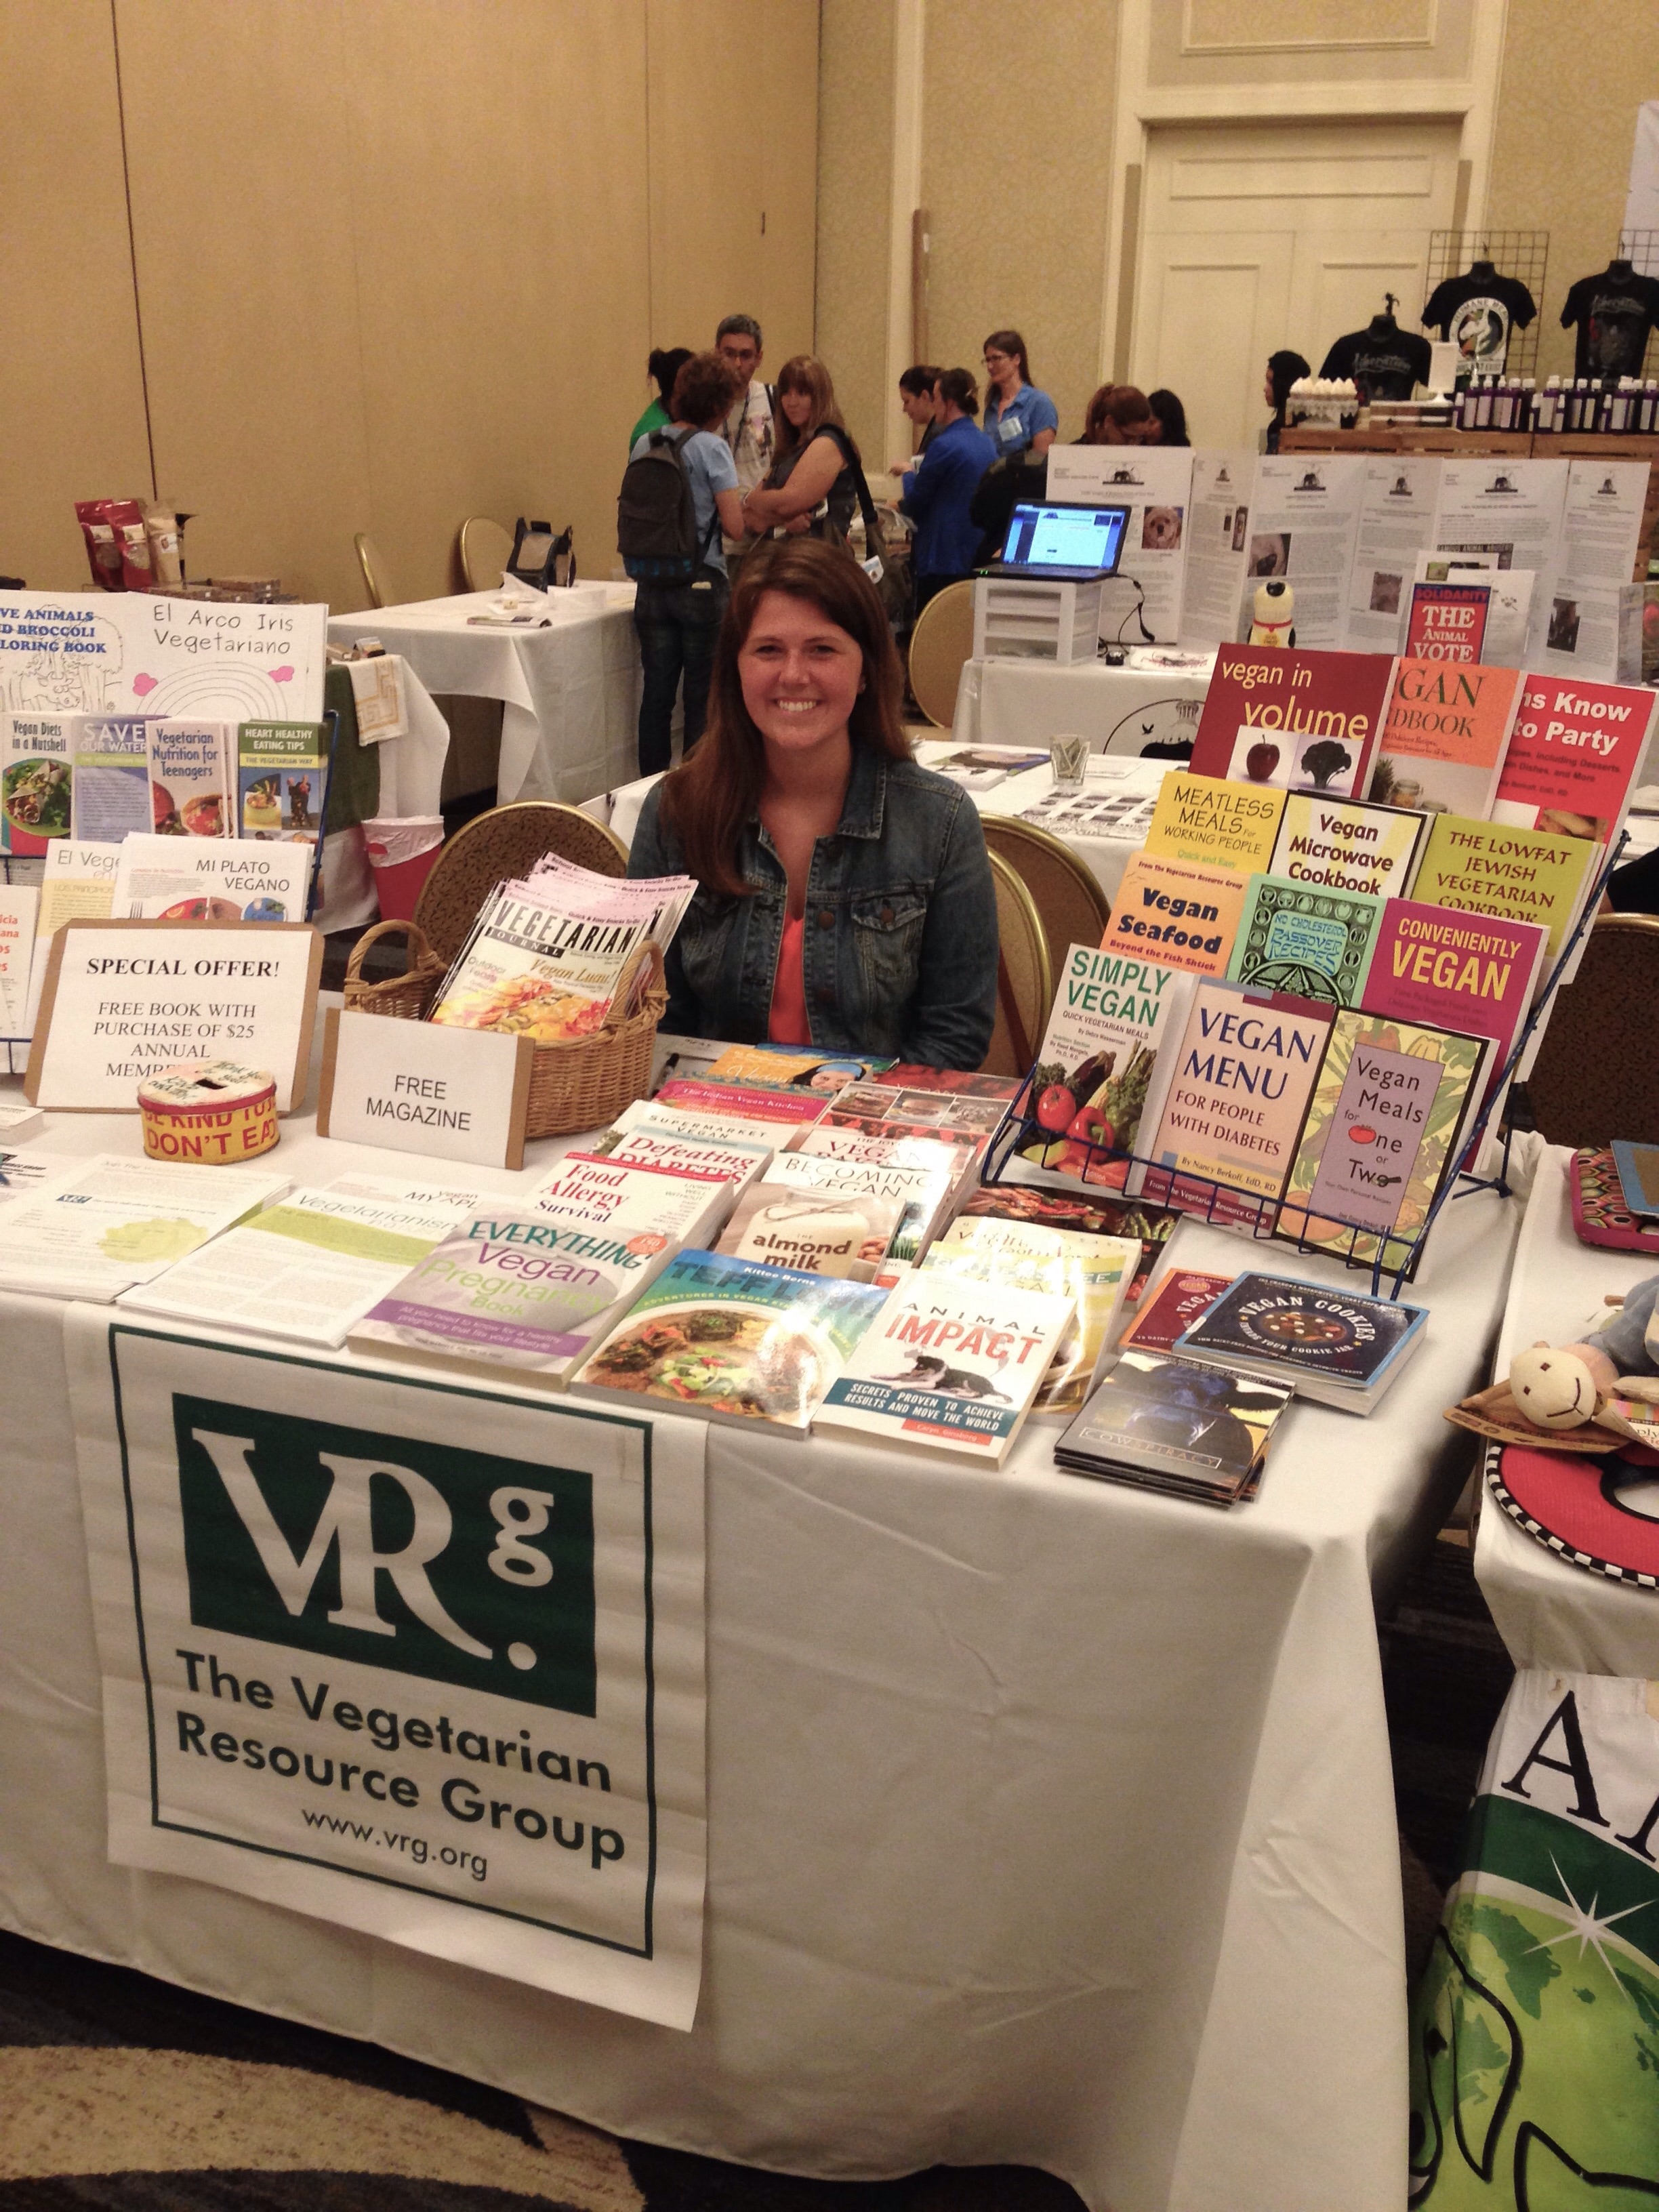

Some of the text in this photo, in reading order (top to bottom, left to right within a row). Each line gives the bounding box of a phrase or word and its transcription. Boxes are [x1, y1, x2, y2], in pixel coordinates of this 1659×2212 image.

[24, 609, 94, 621] ANIMALS
[154, 604, 294, 632] El Arco Iris
[1422, 605, 1476, 629] THE
[18, 624, 95, 637] BROCCOLI
[154, 628, 291, 655] Vegetariano
[0, 640, 106, 653] LORING BOOK
[1414, 642, 1474, 663] VOTE
[1222, 661, 1313, 690] vegan in
[1397, 668, 1486, 709] GAN
[1244, 695, 1369, 740] volume
[1554, 692, 1632, 722] Know
[13, 720, 62, 736] Vegan Diets
[83, 723, 145, 742] SAVE
[156, 729, 213, 747] Vegetarian
[245, 729, 312, 739] HEART HEALTHY
[1393, 708, 1479, 738] DBOOK
[12, 736, 66, 752] in a Nutshell
[253, 741, 304, 751] EATING TIPS
[1545, 722, 1619, 756] Party
[152, 746, 199, 760] Nutrition
[203, 746, 218, 763] for
[160, 760, 213, 780] Teenagers
[1173, 785, 1274, 819] MEATLESS
[1179, 807, 1243, 834] MEALS
[1319, 814, 1379, 842] Vegan
[1164, 825, 1262, 855] WORKING PEOPLE
[1288, 836, 1394, 872] Microwave
[1450, 831, 1572, 866] THE LOWFAT
[196, 860, 215, 872] MI
[221, 861, 270, 874] PLATO
[1177, 849, 1201, 861] Quick
[1218, 855, 1237, 869] Easy
[1465, 856, 1537, 882] JEWISH
[225, 877, 289, 891] VEGANO
[1288, 863, 1382, 896] Cookbook
[1436, 873, 1555, 908] VEGETARIAN
[1143, 887, 1219, 921] Vegan
[1274, 914, 1288, 924] NO
[487, 928, 561, 956] JOURNAL
[494, 900, 637, 954] VEGETARIAN
[1117, 914, 1223, 955] Seafood
[1397, 917, 1521, 960] CONVENIENTLY
[86, 957, 281, 977] SPECIAL OFFER!
[529, 958, 574, 979] Vegan
[1109, 939, 1217, 971] Beyond the Fish Shtick
[1071, 949, 1172, 996] SIMPLY
[1391, 940, 1511, 1002] VEGAN
[98, 1001, 256, 1018] FREE BOOK WITH
[1067, 979, 1161, 1027] VEGAN
[93, 1024, 255, 1039] PURCHASE OF $25
[1063, 1010, 1149, 1040] QUICK VEGETARIAN MEALS
[1200, 1007, 1316, 1063] VEGAN
[129, 1043, 211, 1058] ANNUAL
[394, 1074, 447, 1101] FREE
[1183, 1048, 1289, 1101] MENU
[1356, 1057, 1421, 1092] Vegan
[365, 1098, 472, 1132] MAGAZINE
[703, 1090, 735, 1101] Indian
[737, 1095, 765, 1106] Vegan
[767, 1100, 804, 1111] Kitchen
[1175, 1089, 1265, 1128] FOR PEOPLE
[1343, 1109, 1359, 1122] for
[1357, 1088, 1425, 1123] Meals
[649, 1115, 768, 1137] SUPERMARKET
[677, 1127, 729, 1139] VEGAN
[1170, 1112, 1282, 1158] WITH DIABETES
[147, 1128, 232, 1158] DON'T
[628, 1137, 757, 1170] Defeating
[785, 1158, 933, 1187] BECOMING
[1181, 1157, 1277, 1192] By Nancy Berkoff, EdD, RD
[1375, 1154, 1389, 1166] or
[565, 1164, 629, 1189] Food
[534, 1199, 613, 1223] Survival
[540, 1181, 630, 1212] Allergy
[468, 1221, 653, 1270] EVERYTHING
[752, 1233, 852, 1256] almond
[477, 1243, 601, 1287] Vegan
[668, 1261, 772, 1294] TEFF
[743, 1266, 816, 1286] Kittee Berns
[762, 1254, 823, 1271] milk
[418, 1256, 613, 1317] Pregnancy
[469, 1295, 526, 1317] Book
[903, 1303, 1046, 1336] ANIMAL
[1237, 1295, 1376, 1342] VEGAN COOKIES
[884, 1313, 1043, 1365] IMPACT
[1263, 1338, 1288, 1351] YOUR
[1291, 1345, 1333, 1354] COOKIE
[1335, 1345, 1355, 1354] JAR
[844, 1393, 1000, 1431] RESULTS AND MOVE THE WORLD
[850, 1382, 1005, 1422] SECRETS PROVEN TO ACHIEVE
[1084, 1429, 1218, 1468] COWSPIRACY
[174, 1648, 611, 1793] The Vegetarian
[176, 1710, 626, 1870] Resource Group
[301, 1807, 489, 1882] www.vrg.org
